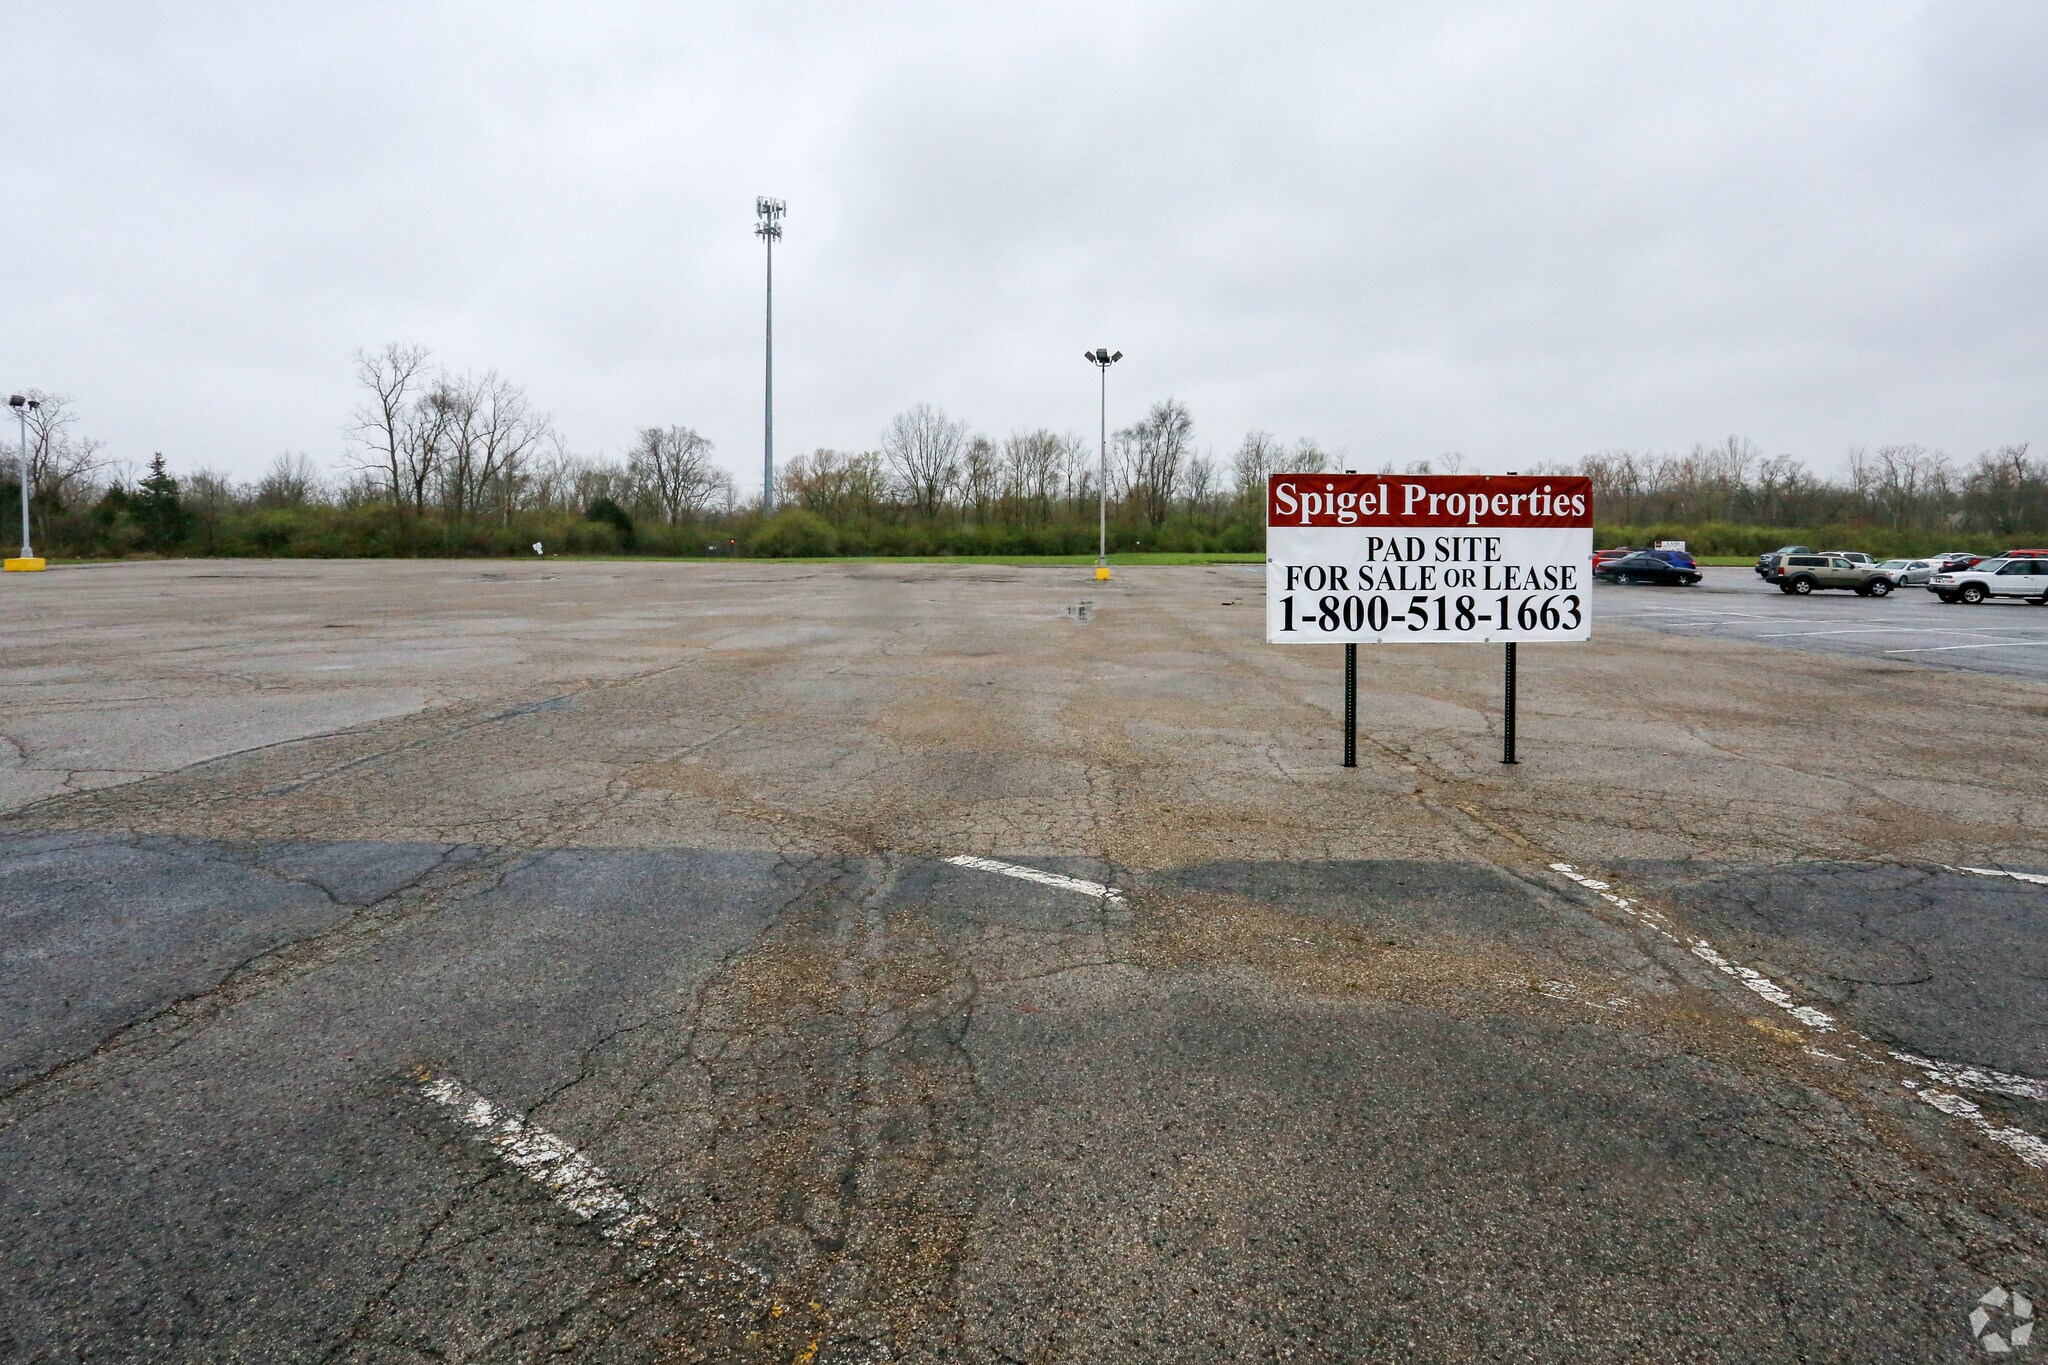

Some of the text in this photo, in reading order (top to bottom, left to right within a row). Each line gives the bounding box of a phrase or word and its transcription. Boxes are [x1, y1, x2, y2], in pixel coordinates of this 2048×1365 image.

[1275, 483, 1586, 525] Spigel Properties
[1366, 536, 1502, 562] PAD SITE
[1284, 565, 1577, 591] FOR SALE OR LEASE
[1279, 594, 1582, 632] 1-800-518-1663
